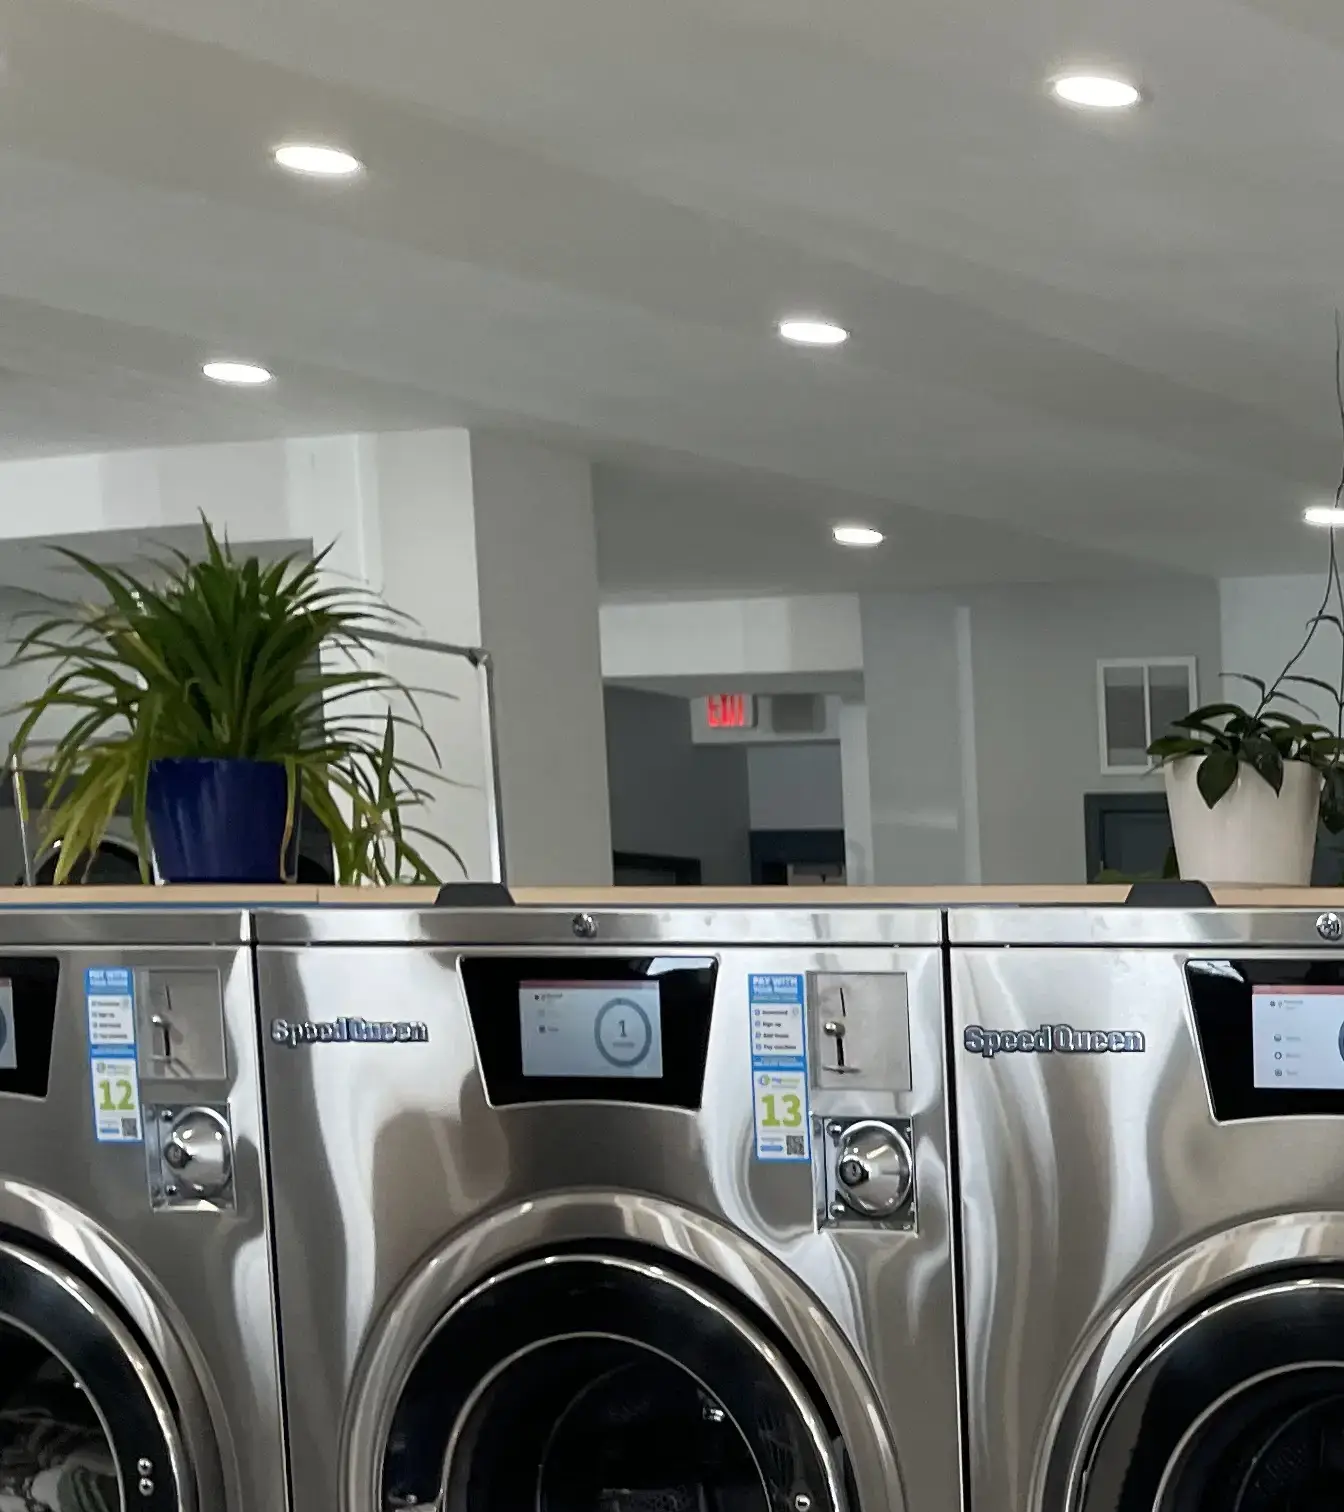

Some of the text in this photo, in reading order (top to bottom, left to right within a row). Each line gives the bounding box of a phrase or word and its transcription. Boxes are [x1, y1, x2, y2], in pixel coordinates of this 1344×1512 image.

[271, 1016, 429, 1048] Speed Queen
[618, 1019, 628, 1038] 1
[964, 1023, 1146, 1058] Speed Queen
[98, 1080, 136, 1111] 12
[761, 1093, 802, 1127] 13
